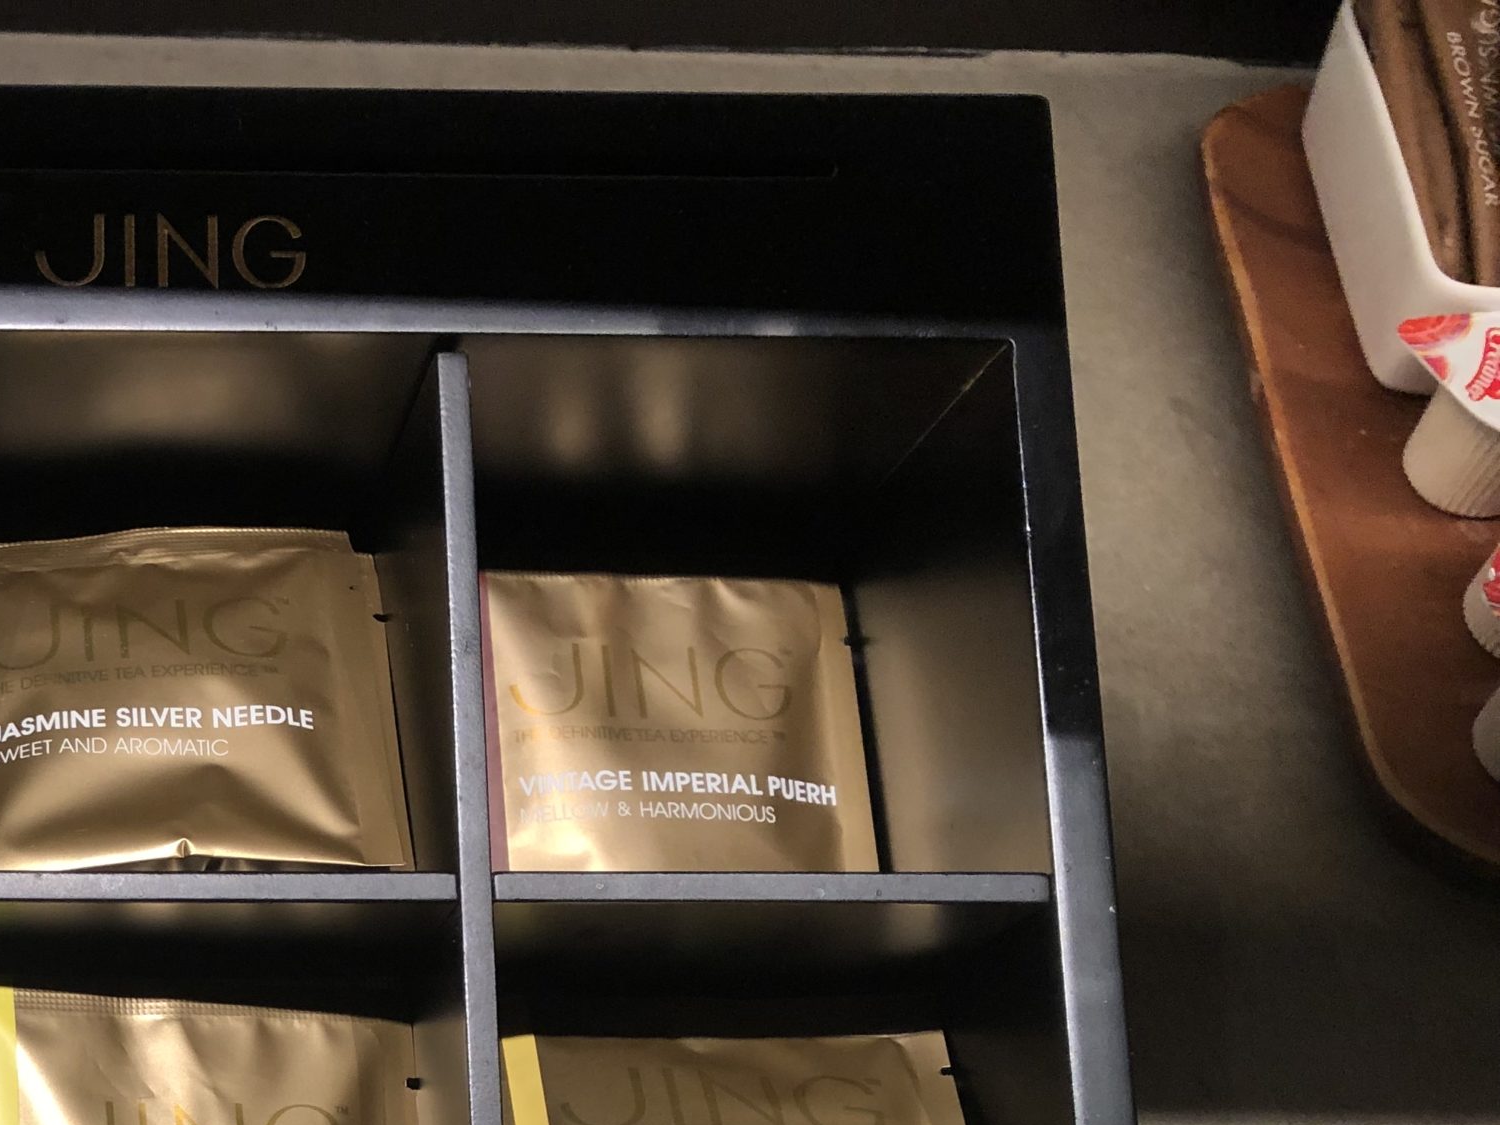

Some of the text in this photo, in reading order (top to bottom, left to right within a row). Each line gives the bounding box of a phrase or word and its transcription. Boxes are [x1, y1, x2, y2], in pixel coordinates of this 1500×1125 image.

[1446, 31, 1481, 119] BROWN
[34, 213, 307, 290] JING
[20, 667, 108, 691] DEFINITIVE
[114, 664, 146, 680] TEA
[151, 661, 259, 679] EXPERIENCE
[509, 642, 792, 721] JING
[116, 706, 202, 730] SILVER
[213, 704, 315, 732] NEEDLE
[58, 736, 108, 756] AND
[114, 736, 230, 758] AROMATIC
[518, 769, 838, 807] VINTAGE IMPERIAL PUERH
[617, 801, 633, 817] &
[639, 801, 777, 825] HARMONIOUS
